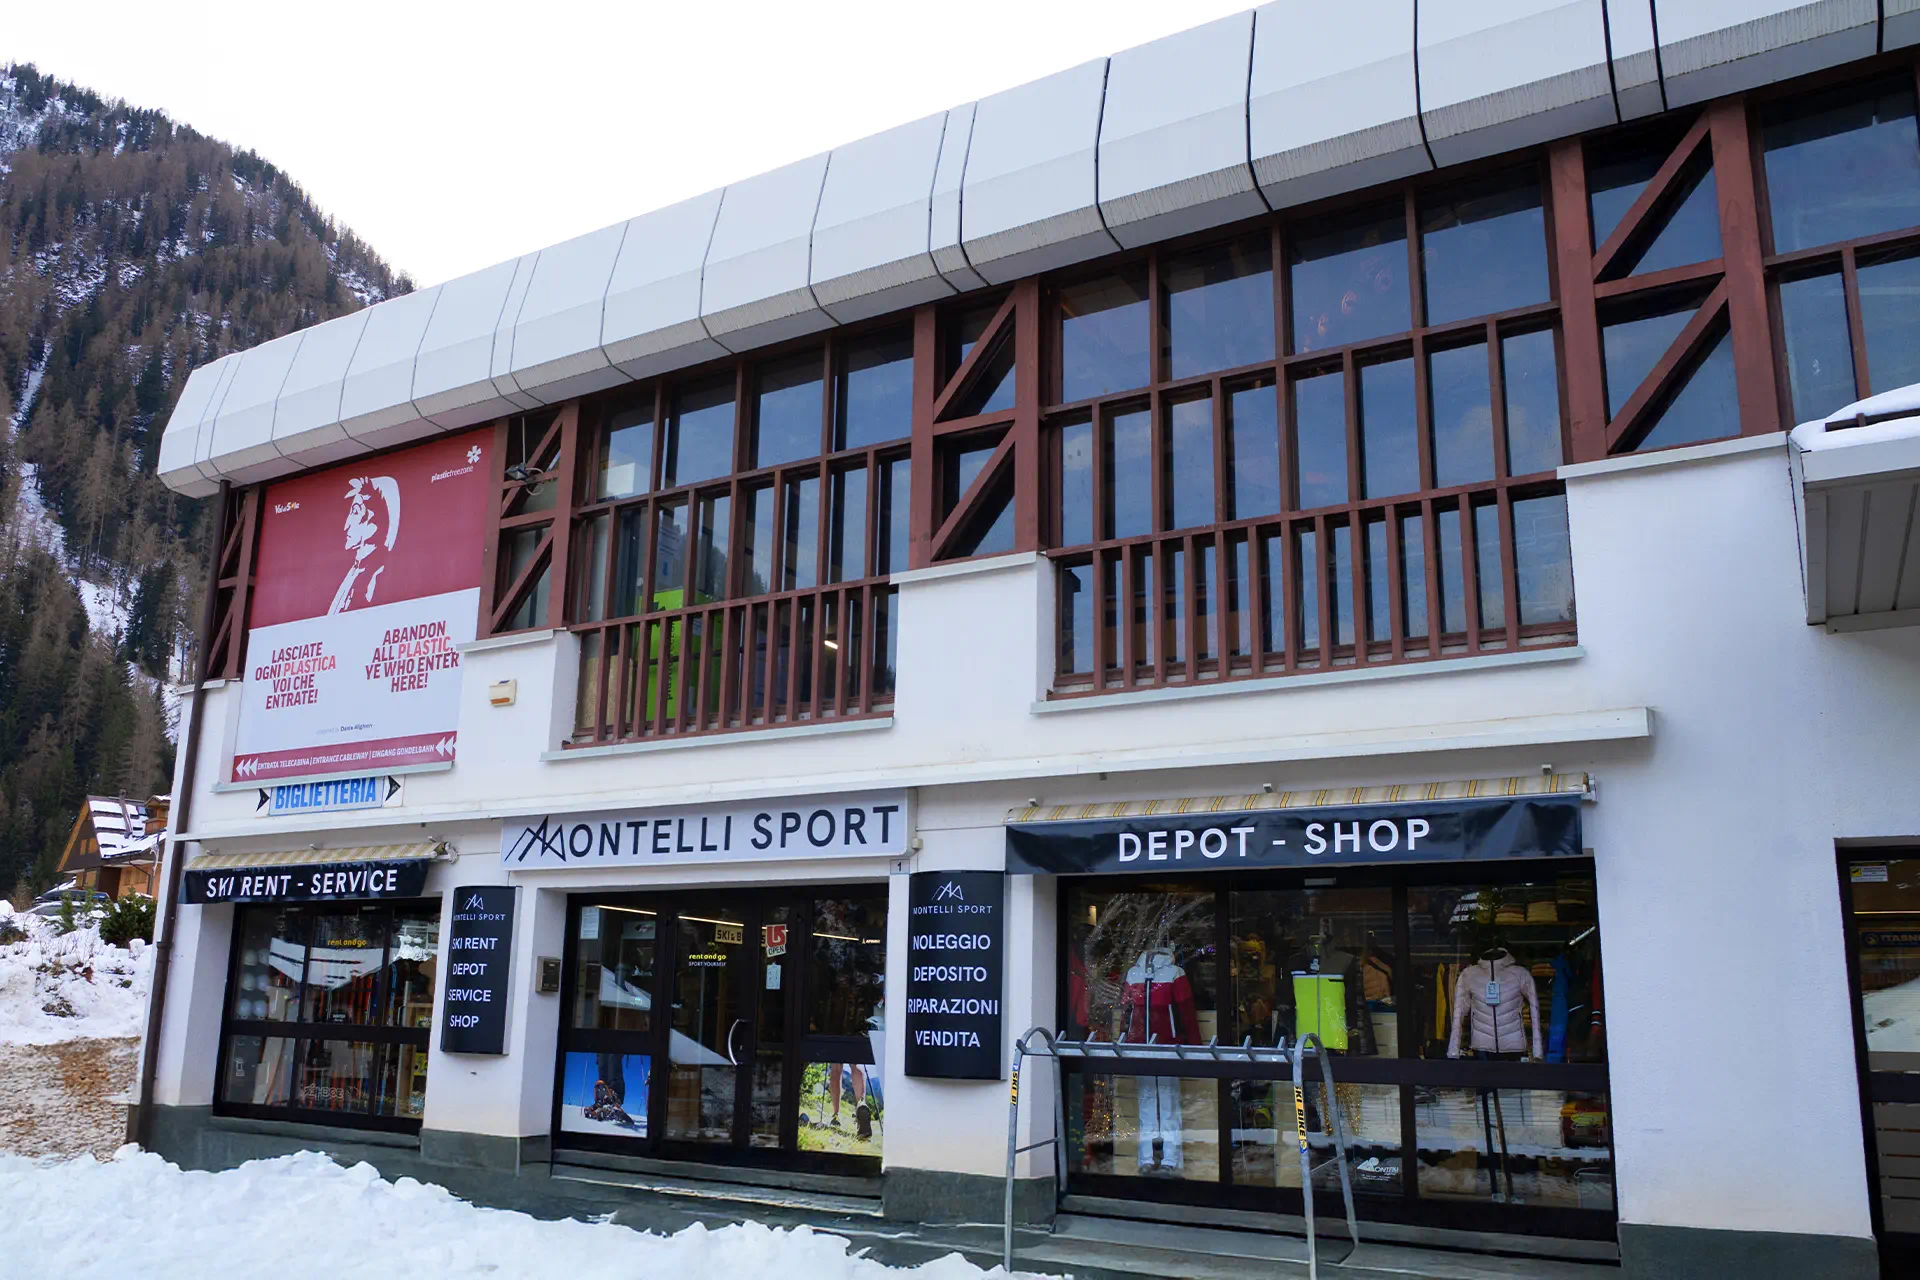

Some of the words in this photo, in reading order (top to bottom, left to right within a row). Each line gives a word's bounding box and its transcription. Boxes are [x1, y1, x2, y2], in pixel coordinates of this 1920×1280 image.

[431, 465, 474, 483] plasticfreezone
[383, 621, 446, 645] ABANDON
[272, 642, 323, 663] LASCIATE
[372, 647, 395, 663] ALL
[255, 664, 281, 681] OGNI
[283, 655, 336, 677] PLASTICA
[365, 664, 380, 680] YE
[384, 658, 415, 678] WHO
[417, 651, 460, 673] ENTER
[273, 676, 291, 693] VOI
[293, 674, 315, 690] CHE
[391, 672, 428, 692] HERE!
[265, 689, 318, 710] ENTRATE!
[257, 759, 279, 771] ENTRATA
[279, 757, 310, 769] TELECABINA
[312, 754, 341, 766] ENTRANCE
[339, 751, 369, 763] CABLEWAY
[372, 748, 397, 759] EINGANG
[396, 744, 435, 757] GONDELBAHN
[275, 777, 377, 810] BIGLIETTERIA
[750, 805, 899, 851] SPORT
[1118, 827, 1255, 862] DEPOT
[1303, 818, 1431, 855] SHOP
[206, 877, 235, 898] SKI
[240, 875, 292, 896] RENT
[310, 869, 398, 895] SERVICE
[478, 913, 506, 921] SPORT
[913, 905, 953, 915] MONTELLI
[957, 905, 993, 914] SPORT
[327, 938, 342, 946] rent
[343, 938, 357, 946] and
[357, 939, 367, 948] go
[452, 937, 463, 950] SKI
[464, 937, 498, 950] RENT
[716, 929, 730, 941] SKI
[913, 934, 991, 950] NOLEGGIO
[1880, 934, 1920, 942] ITASN
[767, 945, 785, 955] OPEN
[452, 963, 487, 976] DEPOT
[913, 966, 987, 982] DEPOSITO
[448, 989, 492, 1002] SERVICE
[907, 998, 998, 1015] RIPARAZIONI
[450, 1015, 479, 1028] SHOP
[915, 1030, 980, 1048] VENDITA
[1297, 1108, 1306, 1137] BIKE
